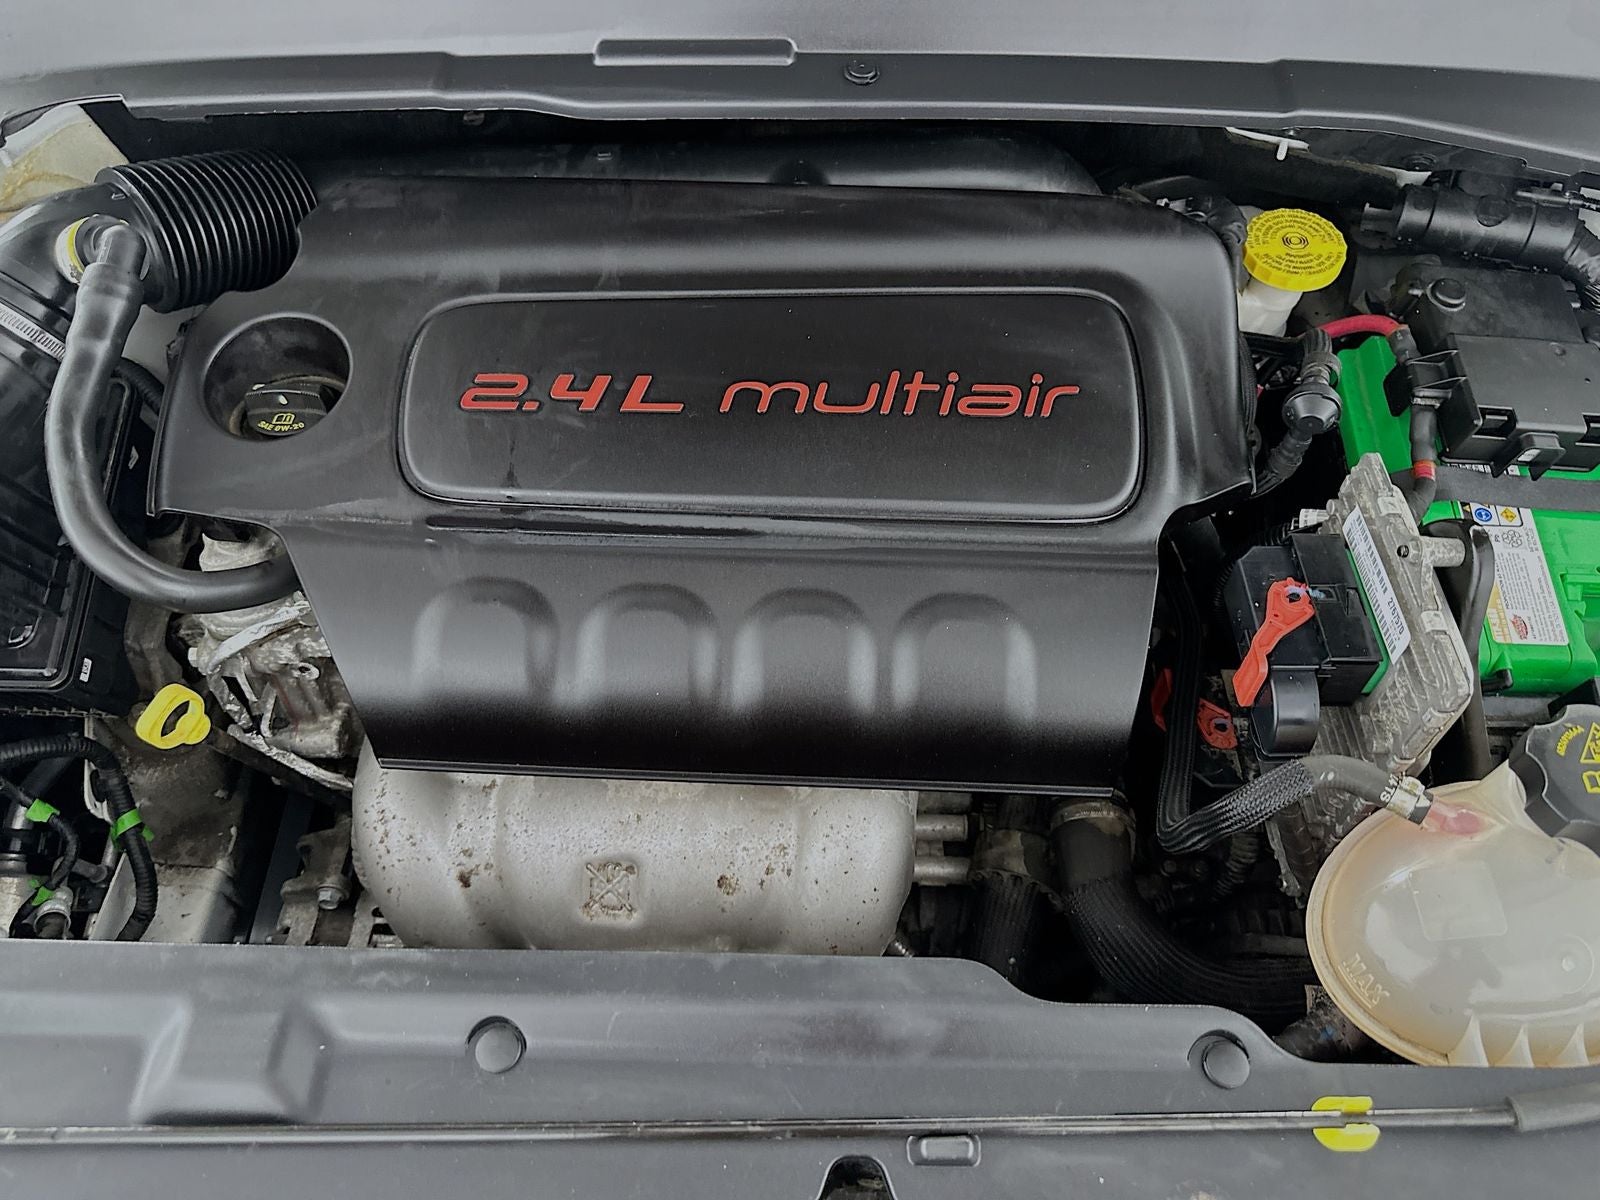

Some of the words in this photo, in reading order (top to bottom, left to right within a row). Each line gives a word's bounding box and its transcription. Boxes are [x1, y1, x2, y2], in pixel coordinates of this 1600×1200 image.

[719, 370, 1080, 418] multiair
[258, 420, 274, 431] SAE
[1342, 952, 1391, 1005] MAX
